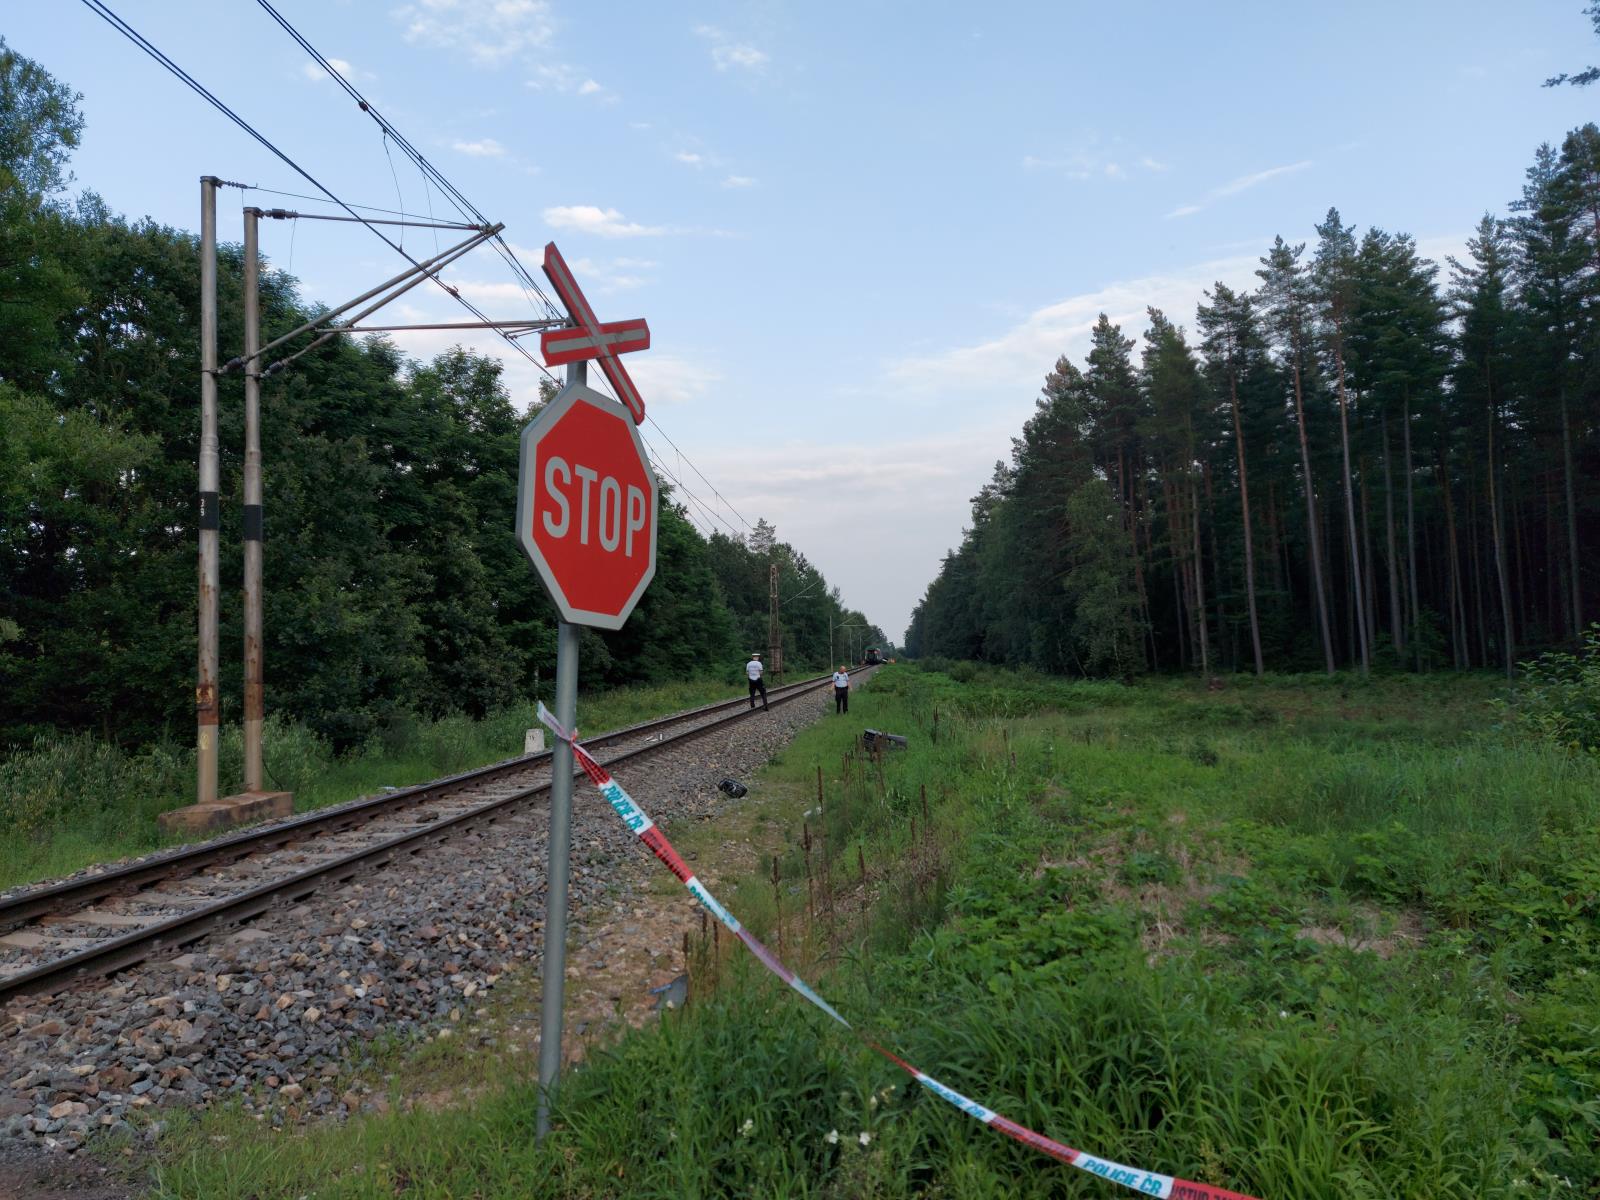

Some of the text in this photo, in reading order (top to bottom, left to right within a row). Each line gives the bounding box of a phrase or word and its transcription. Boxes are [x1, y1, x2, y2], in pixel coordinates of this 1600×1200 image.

[542, 456, 646, 558] STOP
[1082, 1159, 1162, 1195] POLICIE ČR
